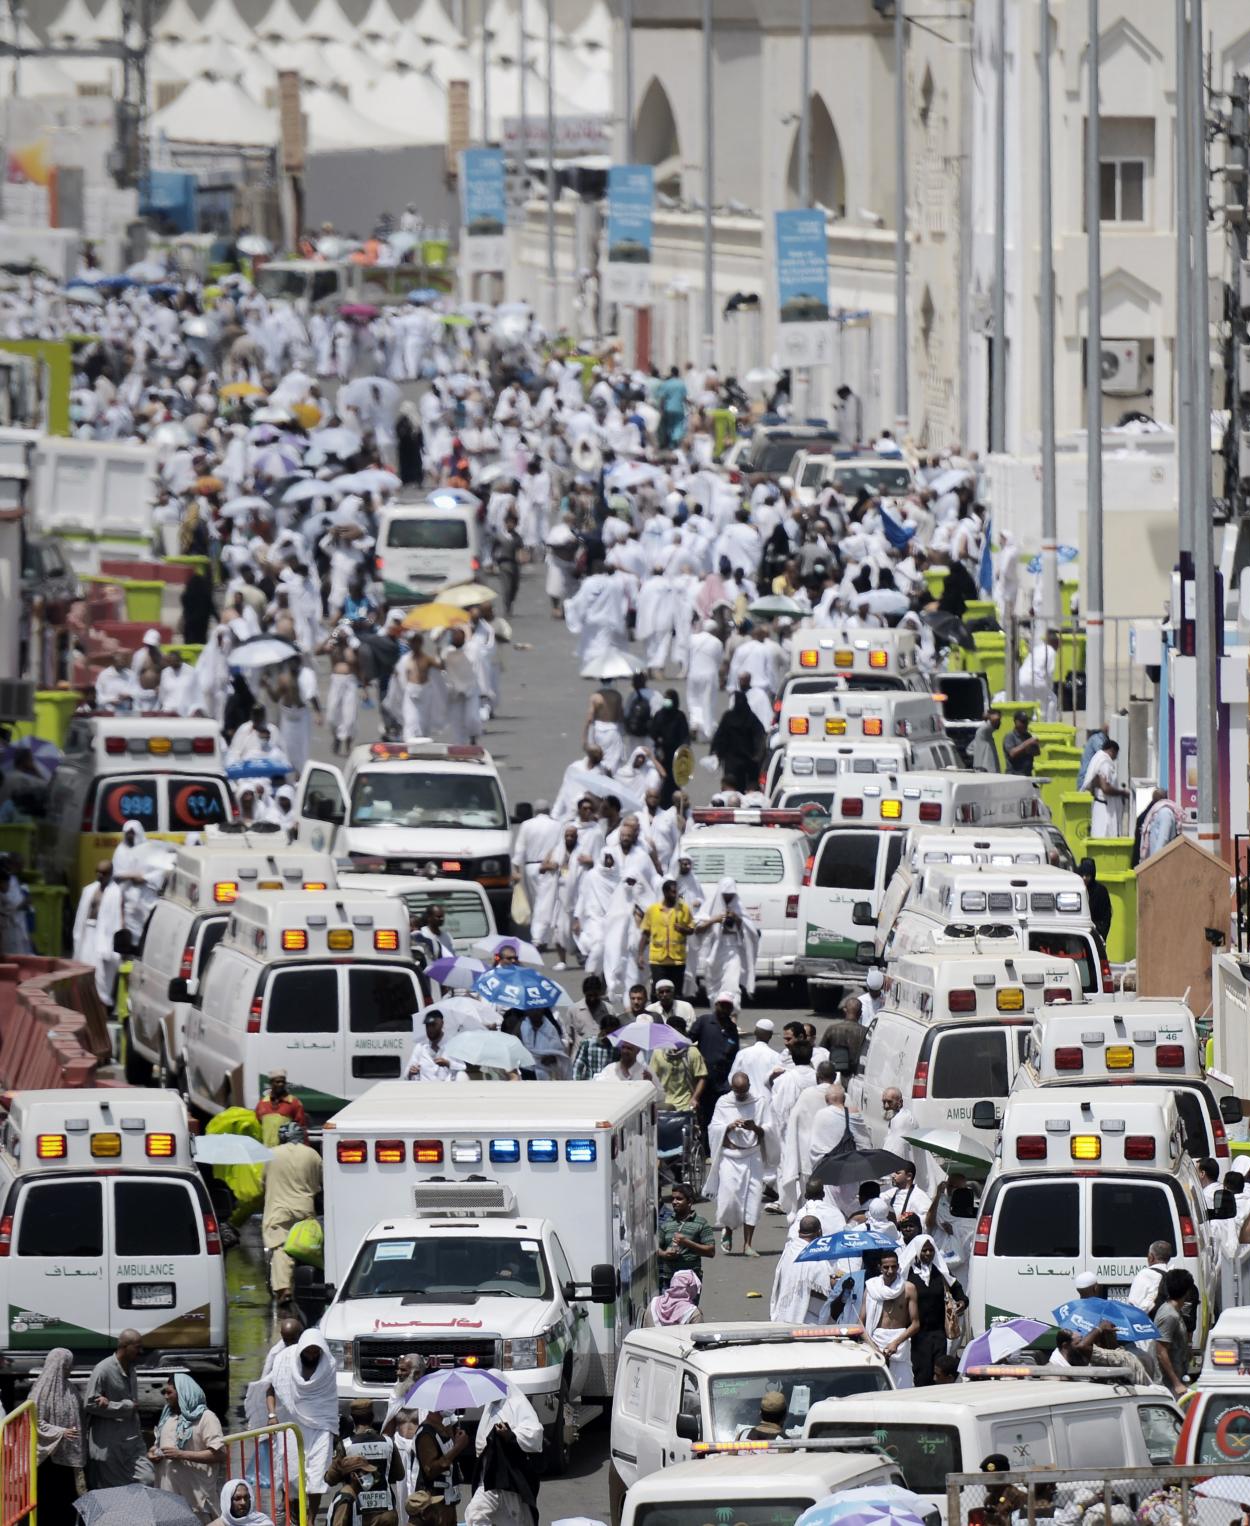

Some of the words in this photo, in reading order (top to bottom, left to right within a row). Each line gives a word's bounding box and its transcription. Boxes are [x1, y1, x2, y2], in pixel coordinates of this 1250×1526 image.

[120, 795, 153, 816] 998
[1053, 975, 1064, 983] 47
[1165, 1032, 1178, 1041] 46
[354, 1039, 403, 1049] AMBULANCE
[947, 1106, 1001, 1119] AMBUE
[45, 1264, 104, 1280] إسعاف
[116, 1263, 175, 1276] AMBULANCE
[1017, 1263, 1076, 1279] إسعاف
[921, 1443, 936, 1455] 12
